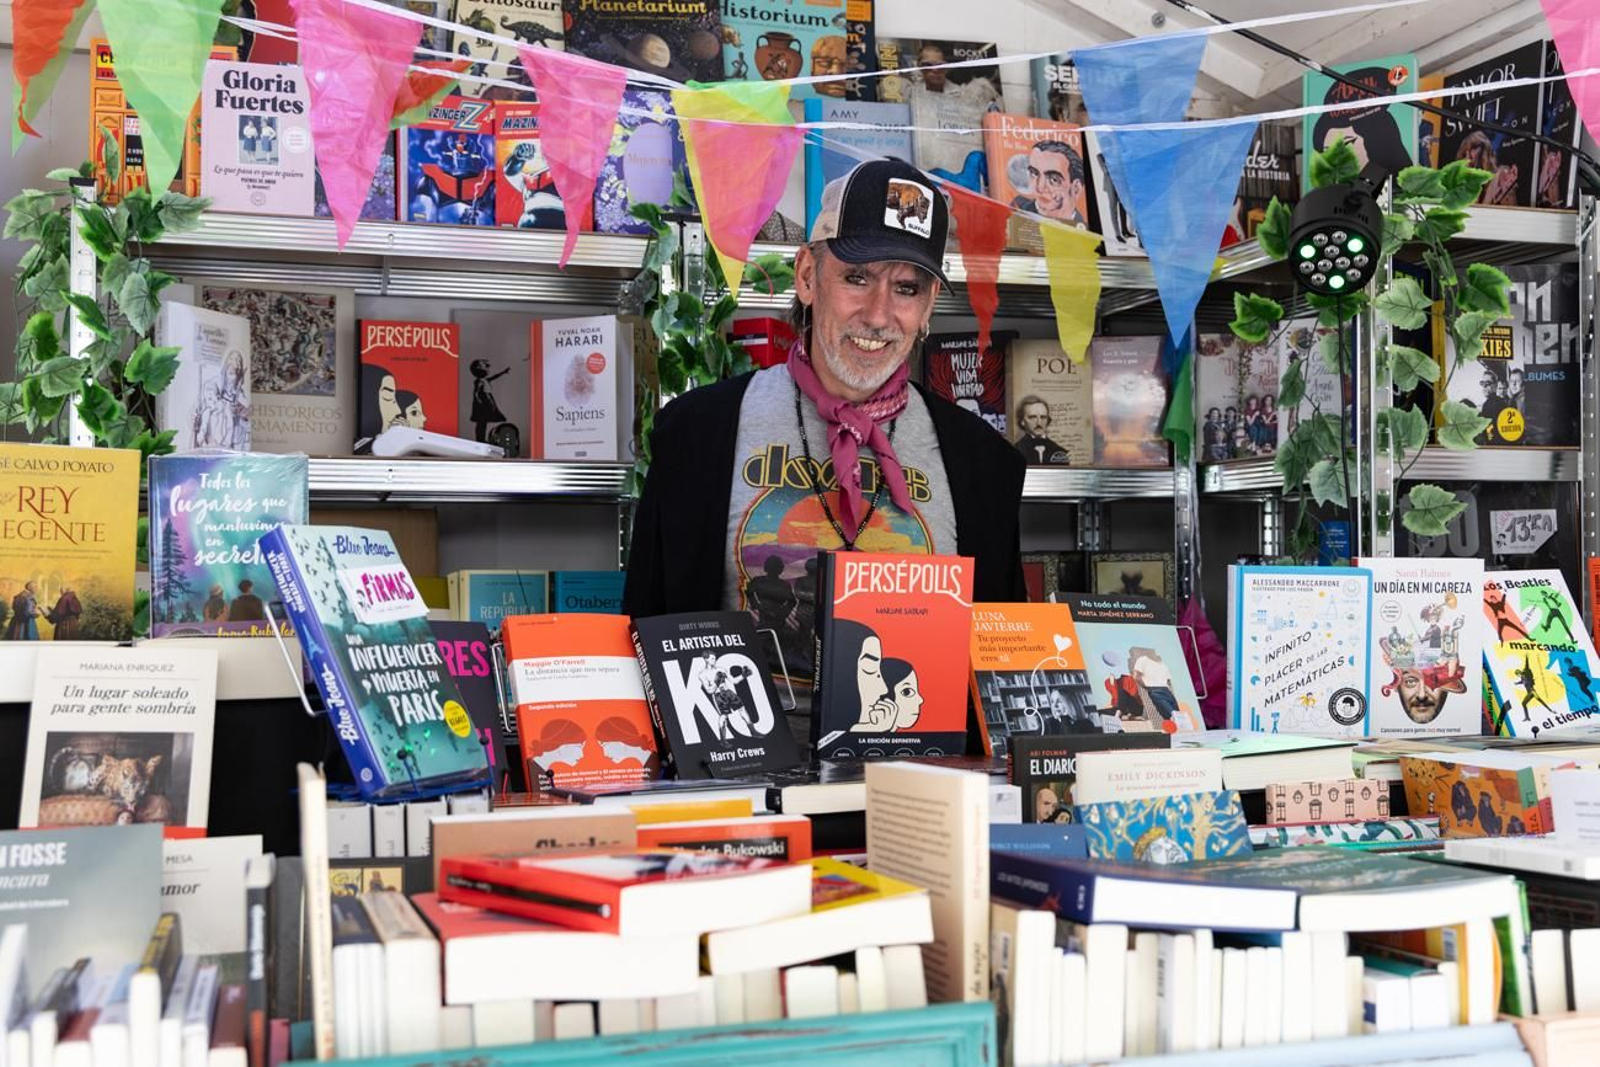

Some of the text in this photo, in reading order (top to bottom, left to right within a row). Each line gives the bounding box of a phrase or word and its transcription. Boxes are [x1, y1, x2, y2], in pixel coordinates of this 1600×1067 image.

[223, 69, 297, 94] Gloria
[215, 89, 305, 115] Fuertes
[830, 109, 859, 119] AMY
[1001, 115, 1079, 148] Federico
[908, 223, 930, 236] BUFFALO
[364, 325, 455, 354] PERSÉPOLIS
[555, 334, 604, 348] HARARI
[950, 353, 983, 371] MUJER
[1037, 357, 1078, 375] POE
[955, 369, 978, 385] VIDA
[555, 406, 606, 426] Sapiens
[14, 458, 115, 473] CALVO POYATO
[199, 471, 251, 491] Todos los
[18, 485, 80, 520] REY
[170, 485, 287, 523] lugares que
[2, 518, 106, 545] EGENTE
[205, 537, 224, 548] en
[332, 534, 396, 558] Blue Jeans
[838, 560, 969, 603] PERSÉPOLIS
[1396, 569, 1418, 578] Santi
[1252, 579, 1340, 588] ALESSANDRO MACCARRONE
[1374, 579, 1473, 594] UN DÍA EN MI CABEZA
[1504, 577, 1552, 590] Beatles
[502, 592, 515, 605] LA
[1080, 600, 1147, 610] No todo el mundo
[972, 611, 1006, 621] LUNA
[974, 622, 1034, 631] JAVIERRE
[662, 634, 745, 652] EL ARTISTA DEL
[975, 634, 1027, 644] Tu proyecto
[1509, 641, 1577, 653] marcando
[998, 644, 1047, 654] importante
[1264, 631, 1312, 664] INFINITO
[348, 642, 443, 672] INFLUENCER
[553, 659, 586, 667] O'Farrell
[79, 662, 176, 673] MARIANA ENRIQUEZ
[536, 667, 568, 675] distancia
[1264, 658, 1303, 687] PLACER
[369, 668, 441, 695] MUERTA EN
[1264, 656, 1345, 708] MATEMÁTICAS
[63, 685, 189, 701] Un lugar soleado
[662, 653, 775, 745] KO
[50, 701, 197, 716] para gente sombría
[321, 661, 360, 746] Blue Jeans
[387, 687, 446, 728] PARÍS
[528, 702, 578, 712] Segunda edición
[1542, 704, 1600, 730] el tiempo
[710, 747, 765, 762] Harry Crews
[1030, 759, 1042, 775] EL
[1107, 769, 1207, 782] EMILY DICKINSON
[10, 842, 67, 867] FOSSE
[723, 841, 785, 858] Bukowski
[166, 855, 193, 864] MESA
